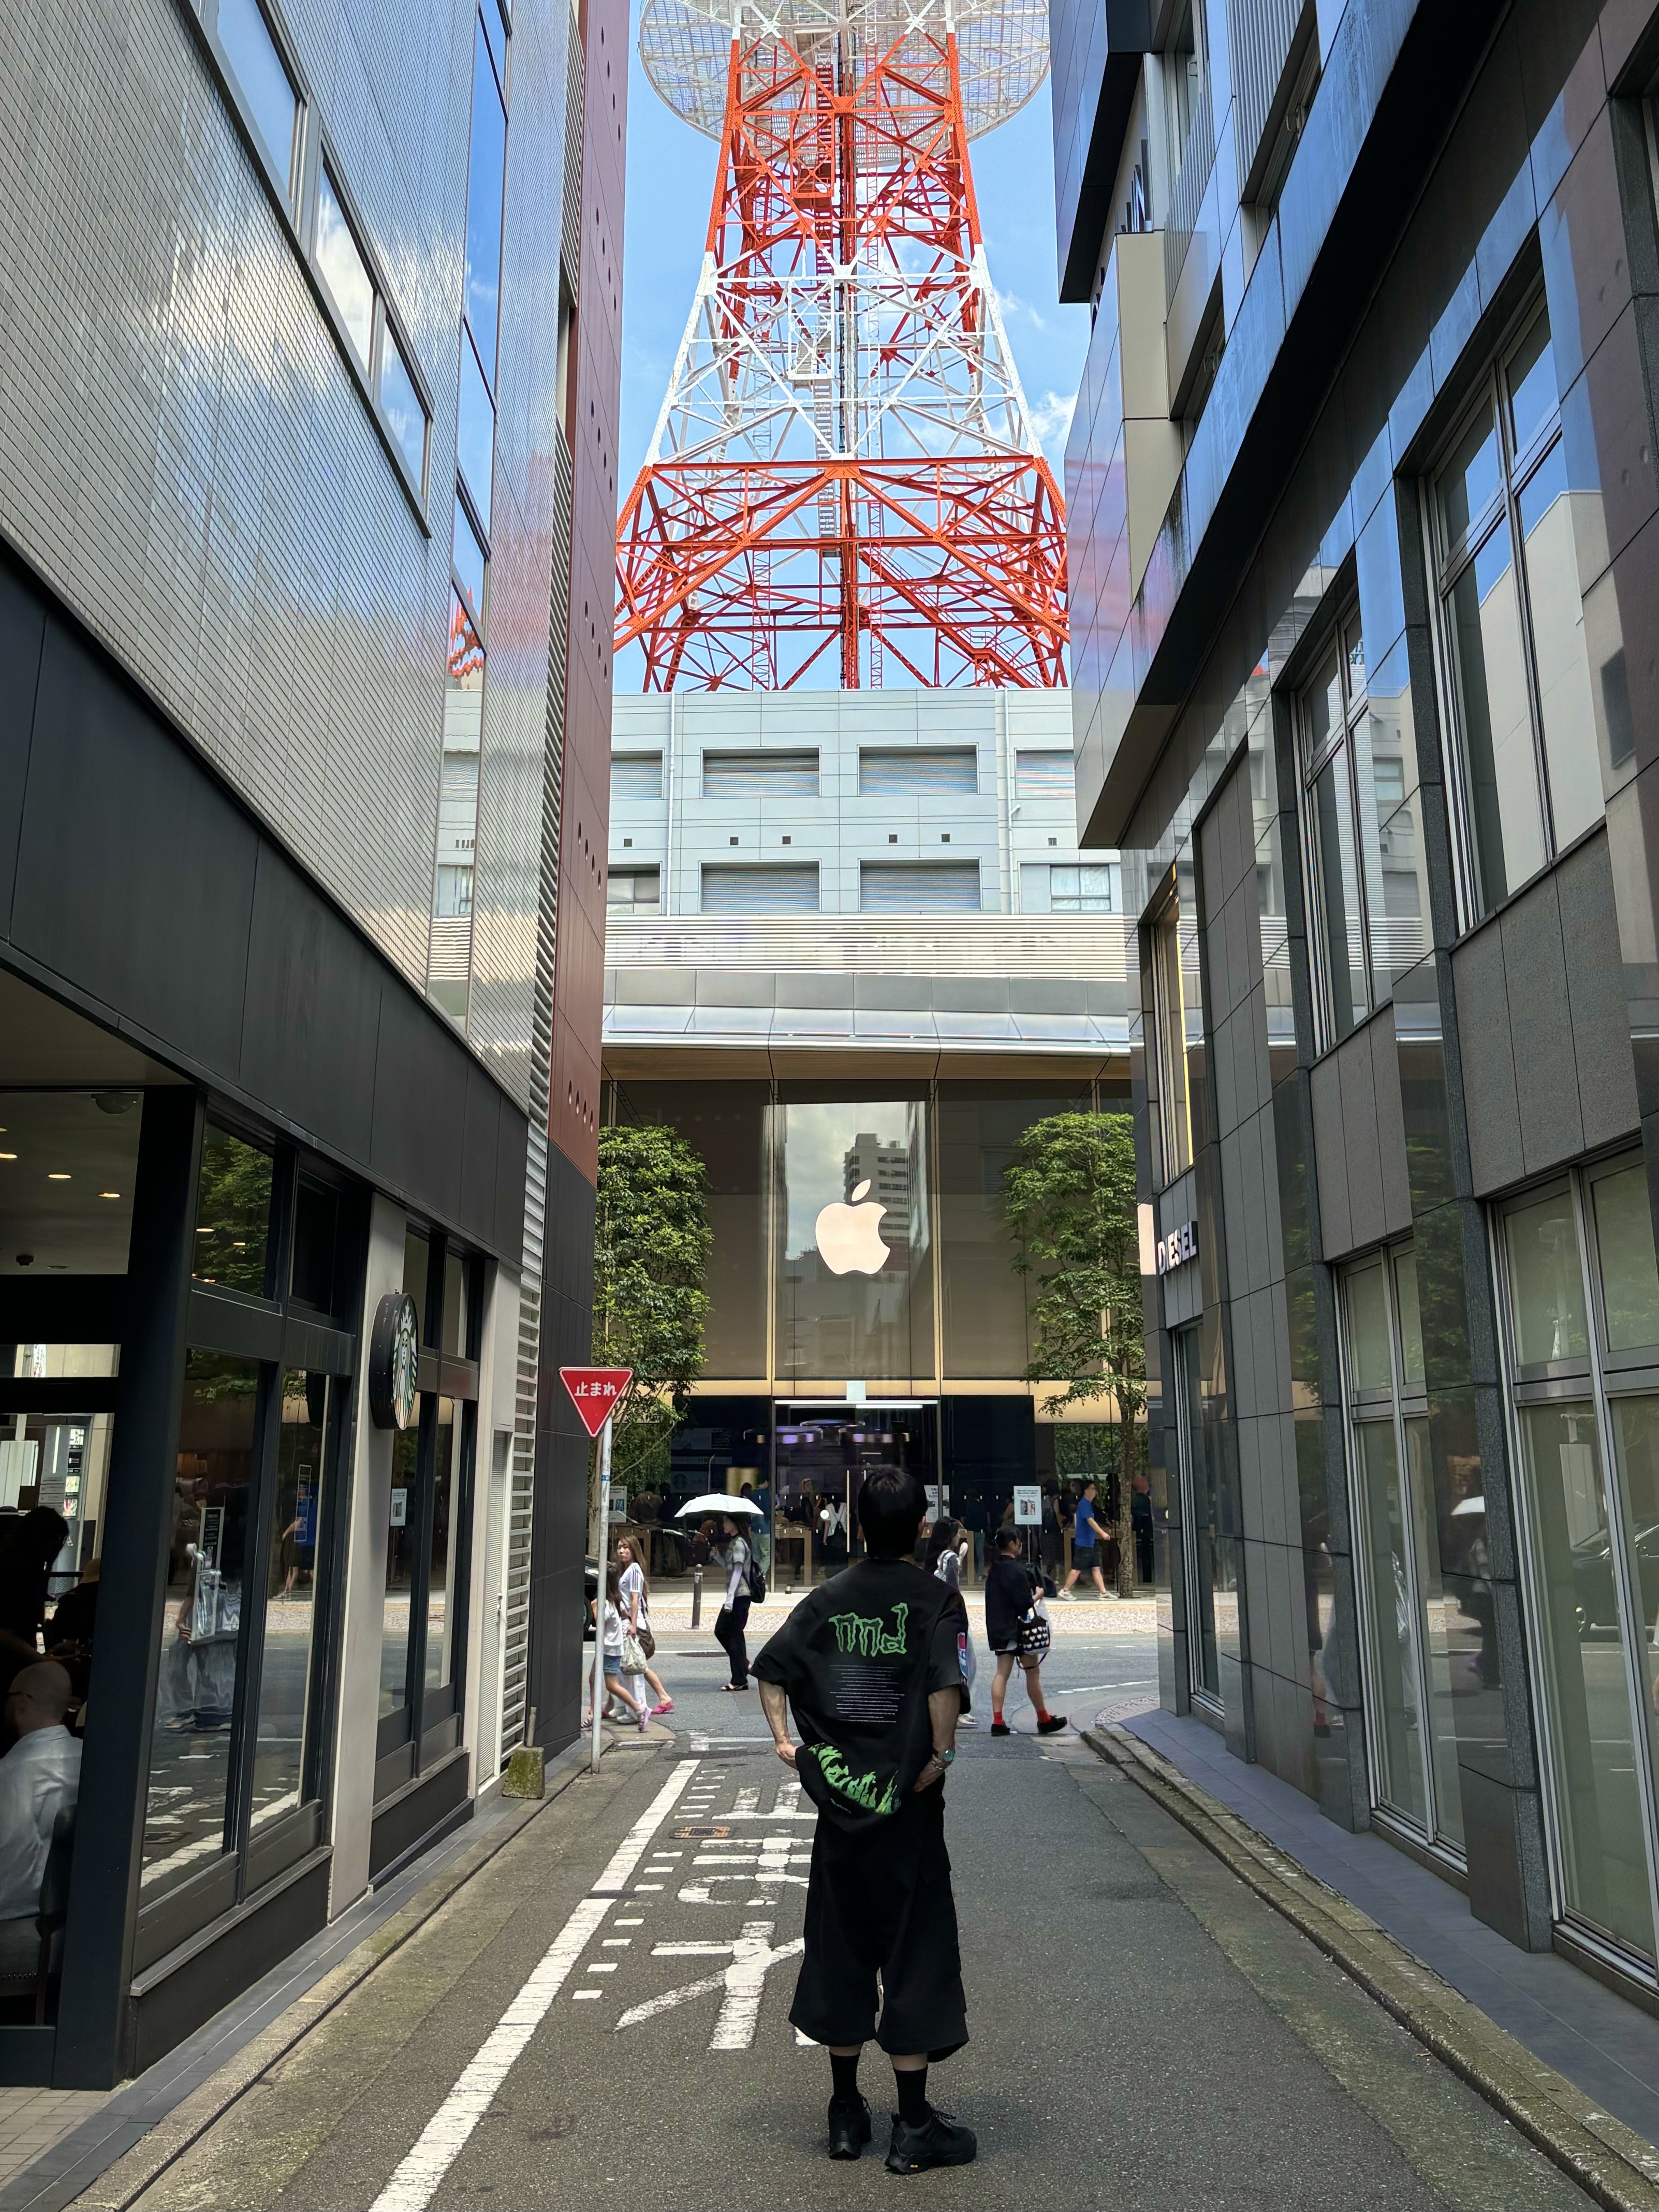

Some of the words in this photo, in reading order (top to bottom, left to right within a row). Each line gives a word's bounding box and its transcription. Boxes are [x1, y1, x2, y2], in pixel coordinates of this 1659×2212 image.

[1157, 1221, 1196, 1275] DIESEL
[574, 1381, 617, 1396] 止まれ
